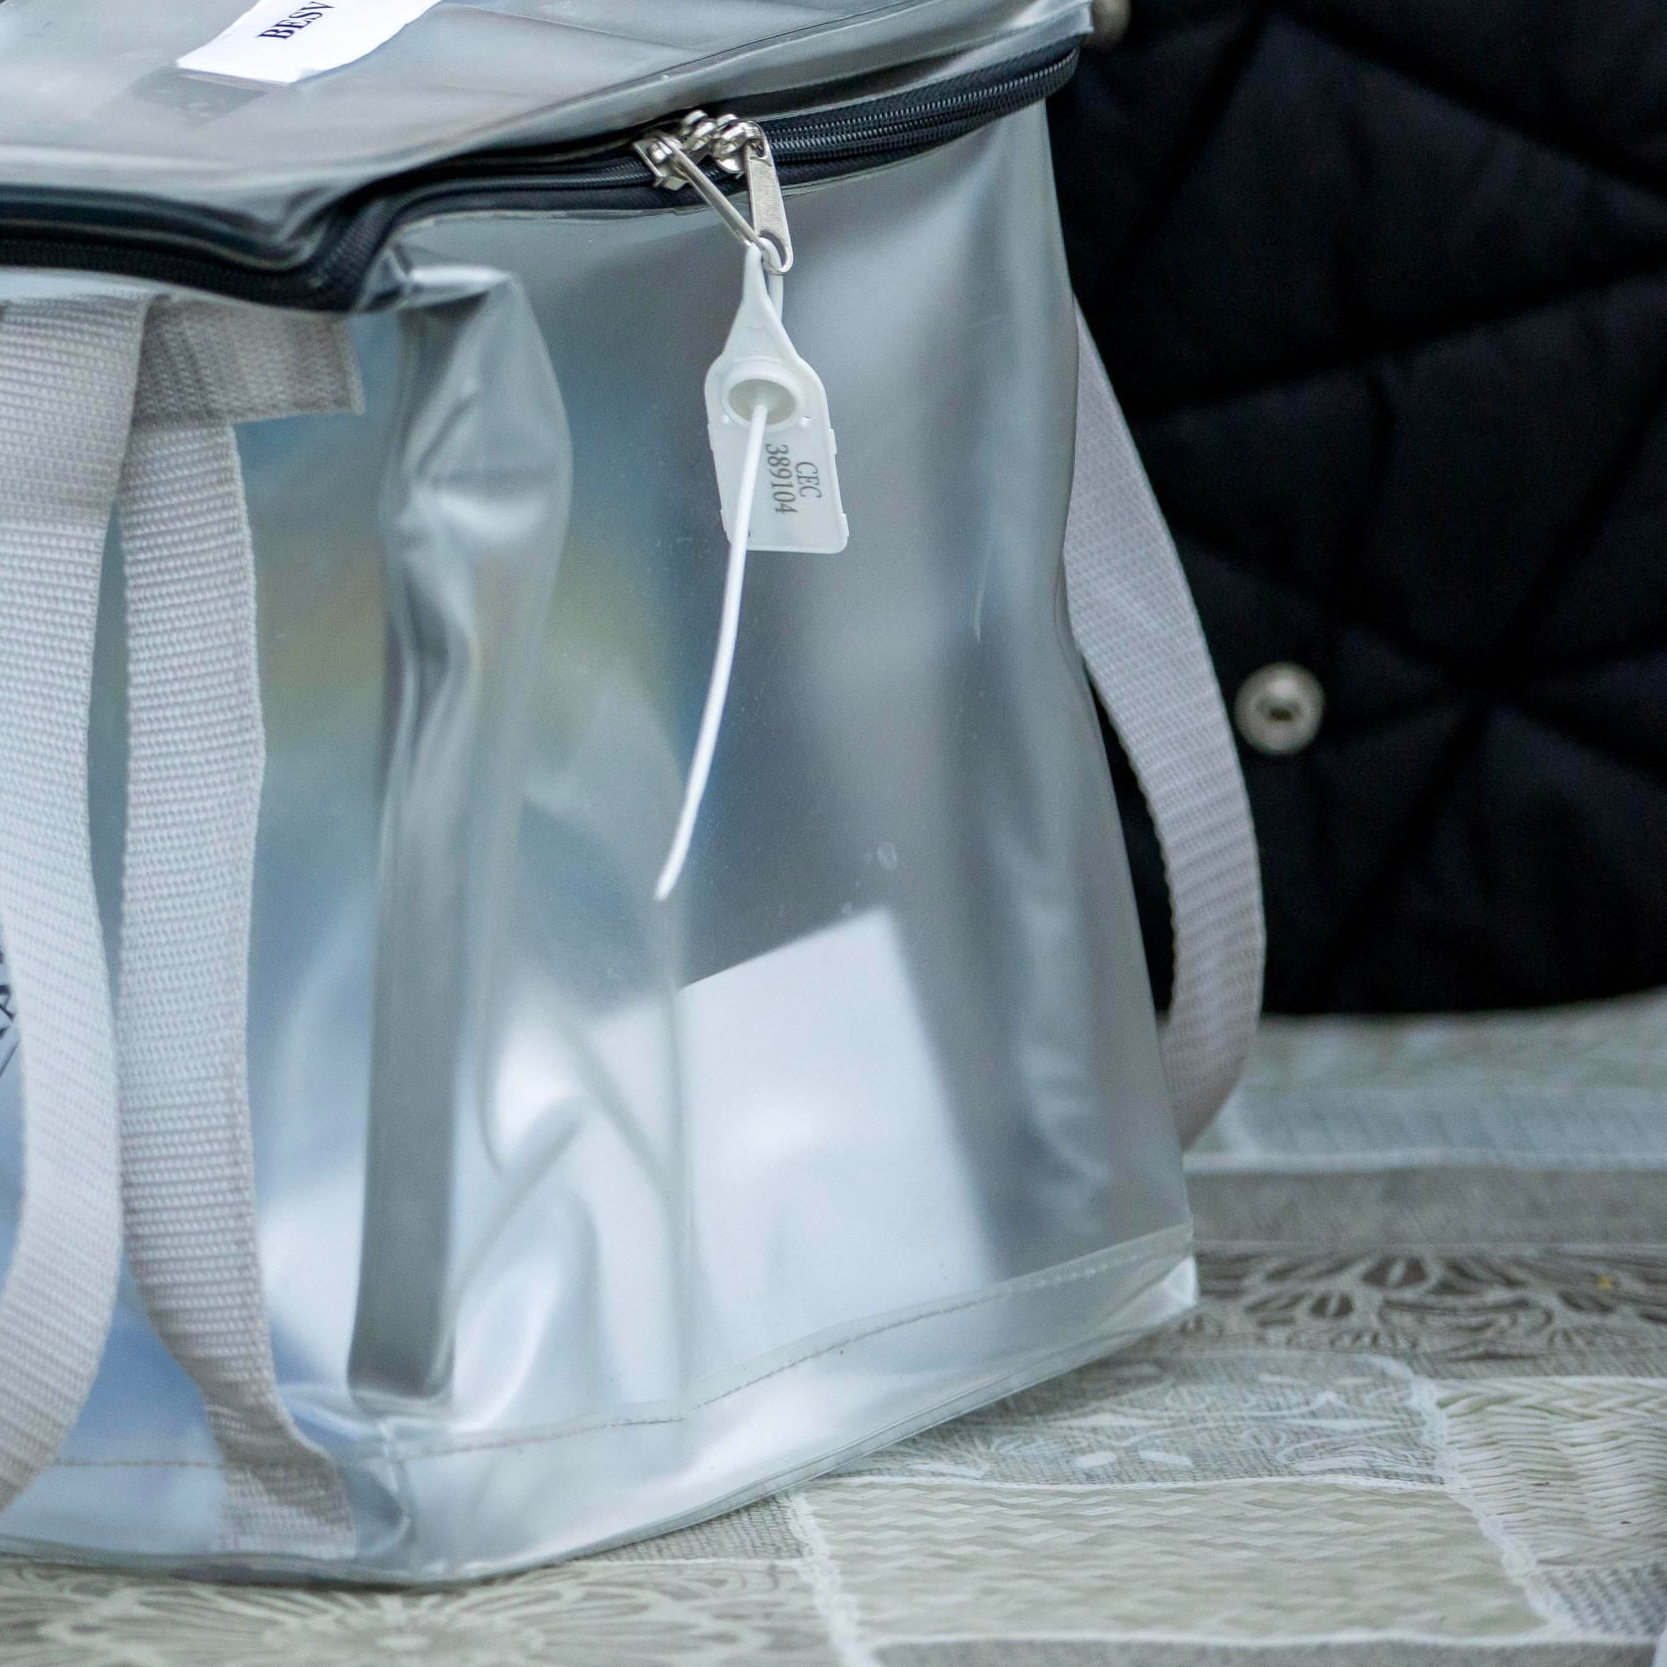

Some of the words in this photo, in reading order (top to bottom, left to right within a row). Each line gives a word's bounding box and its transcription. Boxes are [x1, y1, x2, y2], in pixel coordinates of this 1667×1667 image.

[256, 1, 336, 40] BESV
[765, 443, 798, 515] 389104
[794, 460, 823, 499] CEC
